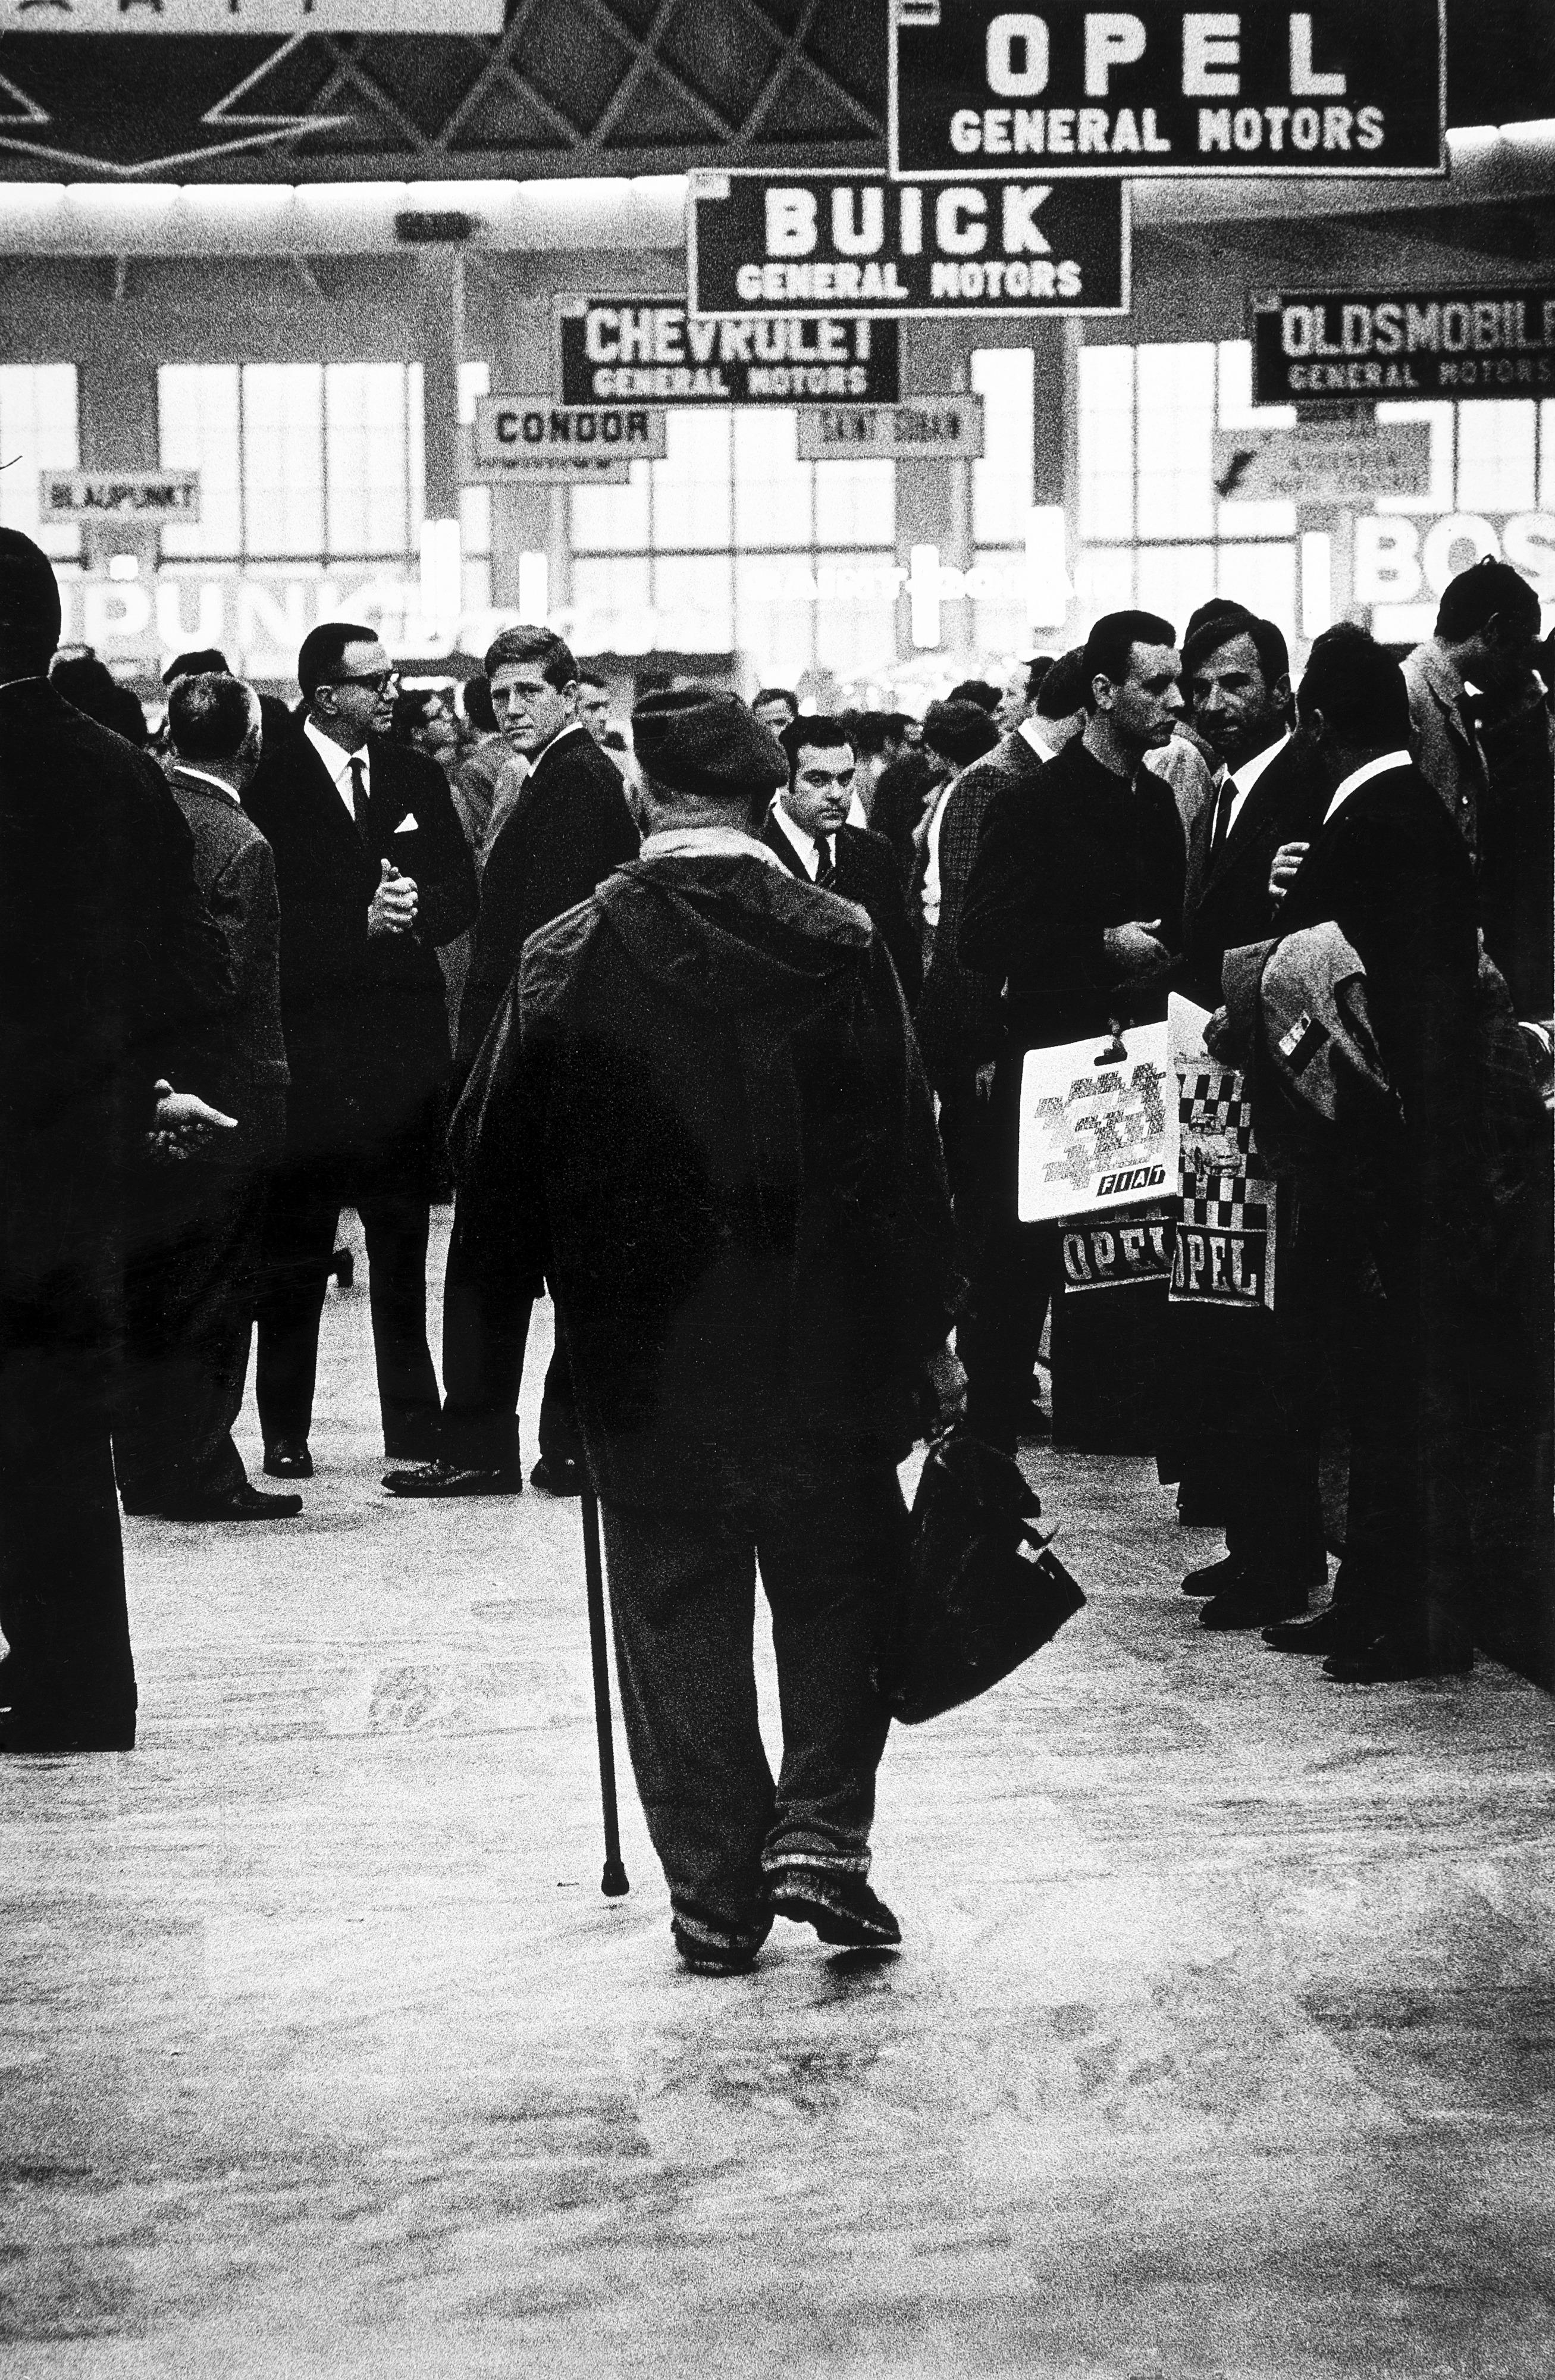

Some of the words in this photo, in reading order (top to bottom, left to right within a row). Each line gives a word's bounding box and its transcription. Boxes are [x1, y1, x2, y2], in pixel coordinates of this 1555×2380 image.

[986, 13, 1346, 96] OPEL
[950, 108, 1171, 154] GENERAL
[1199, 107, 1384, 152] MOTORS
[764, 185, 1052, 257] BUICK
[736, 262, 909, 299] GENERAL
[930, 260, 1082, 298] MOTORS
[592, 367, 731, 397] GENERAL
[745, 364, 868, 396] MOTORS
[1287, 362, 1419, 392] GENERAL
[496, 411, 648, 443] CONDOR
[50, 483, 196, 510] BLAUPUNKT
[1099, 1165, 1166, 1195] FIAT
[1062, 1226, 1174, 1280] OPEL
